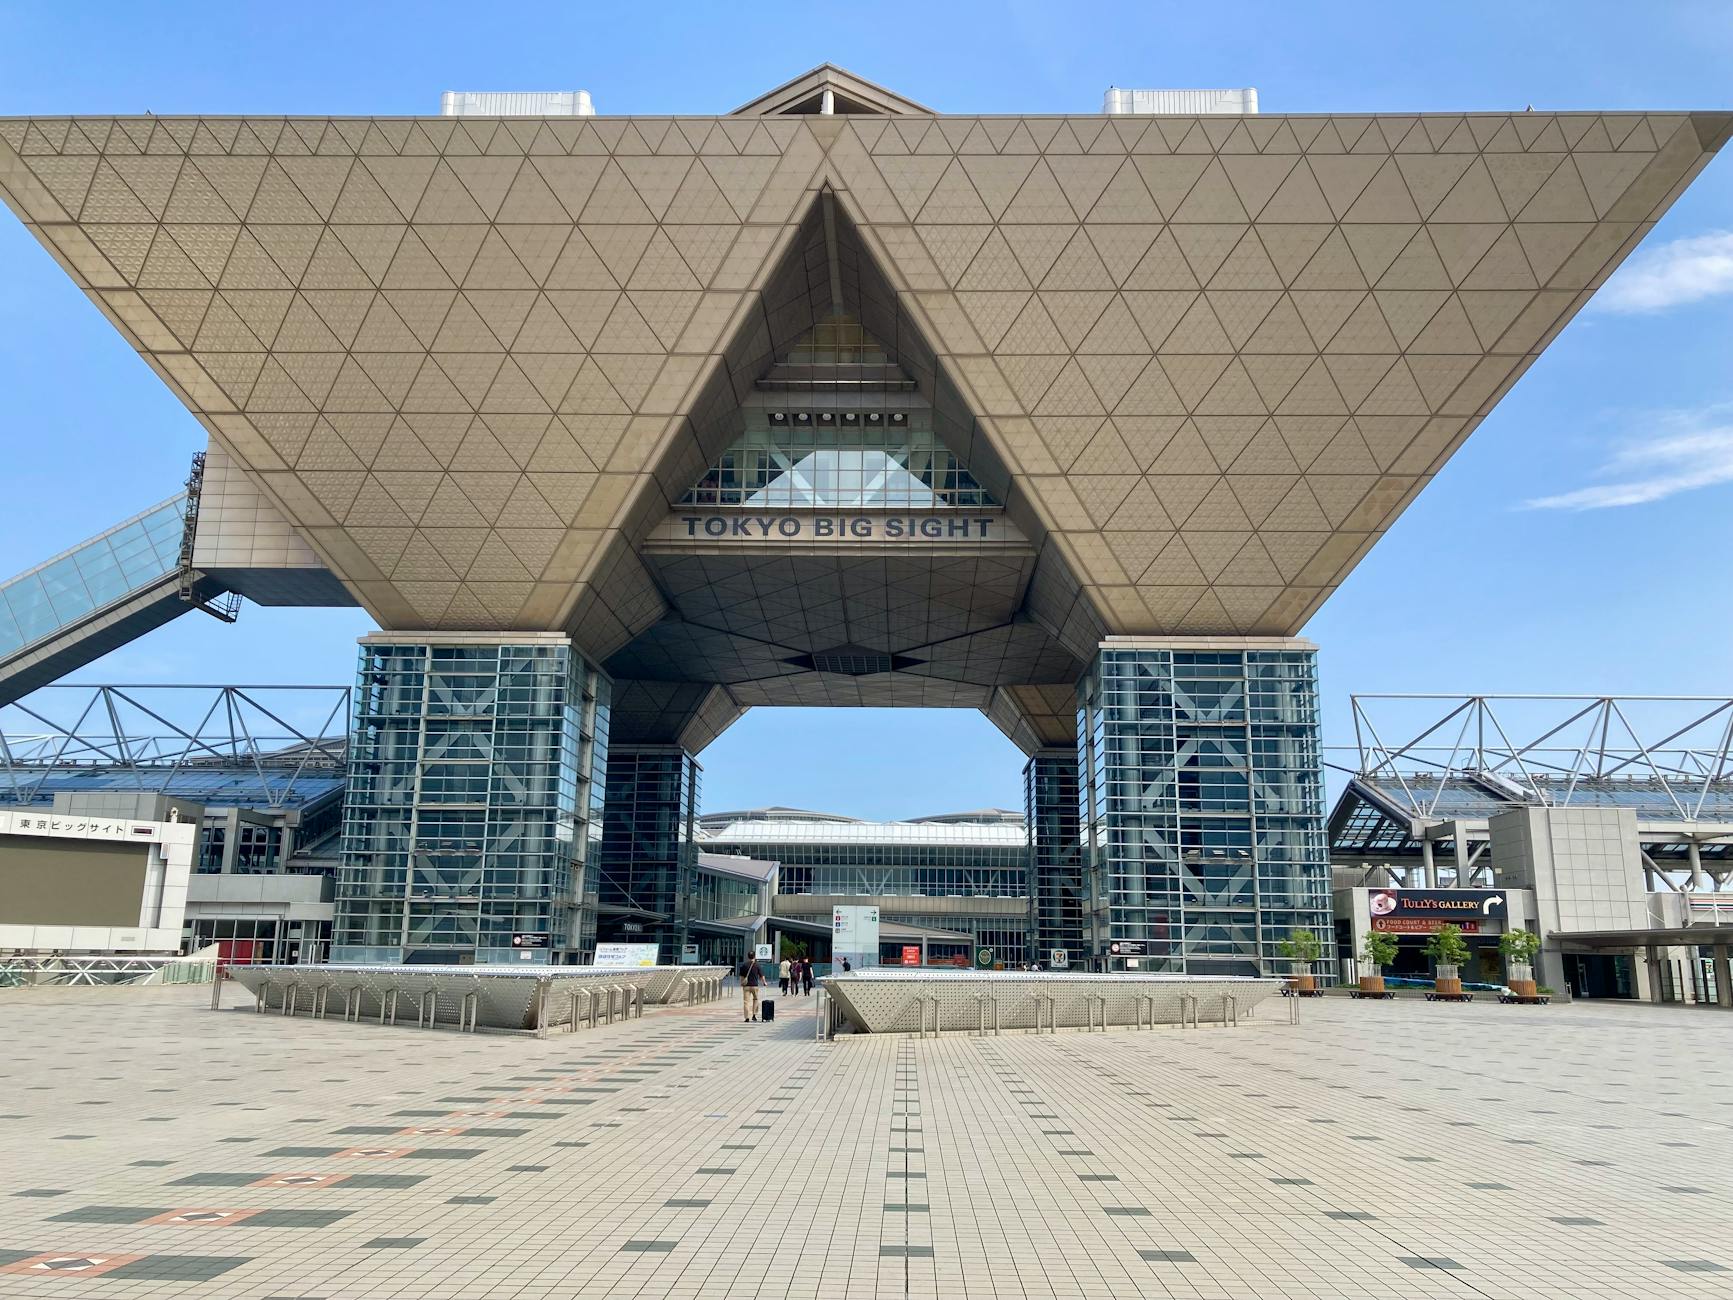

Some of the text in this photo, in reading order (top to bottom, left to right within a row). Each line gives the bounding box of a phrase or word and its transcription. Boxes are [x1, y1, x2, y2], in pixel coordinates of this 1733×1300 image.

[682, 517, 994, 537] TOKYO BIG SIGHT
[20, 819, 124, 834] 東京ビッグサイト
[1438, 901, 1479, 909] GALLERY
